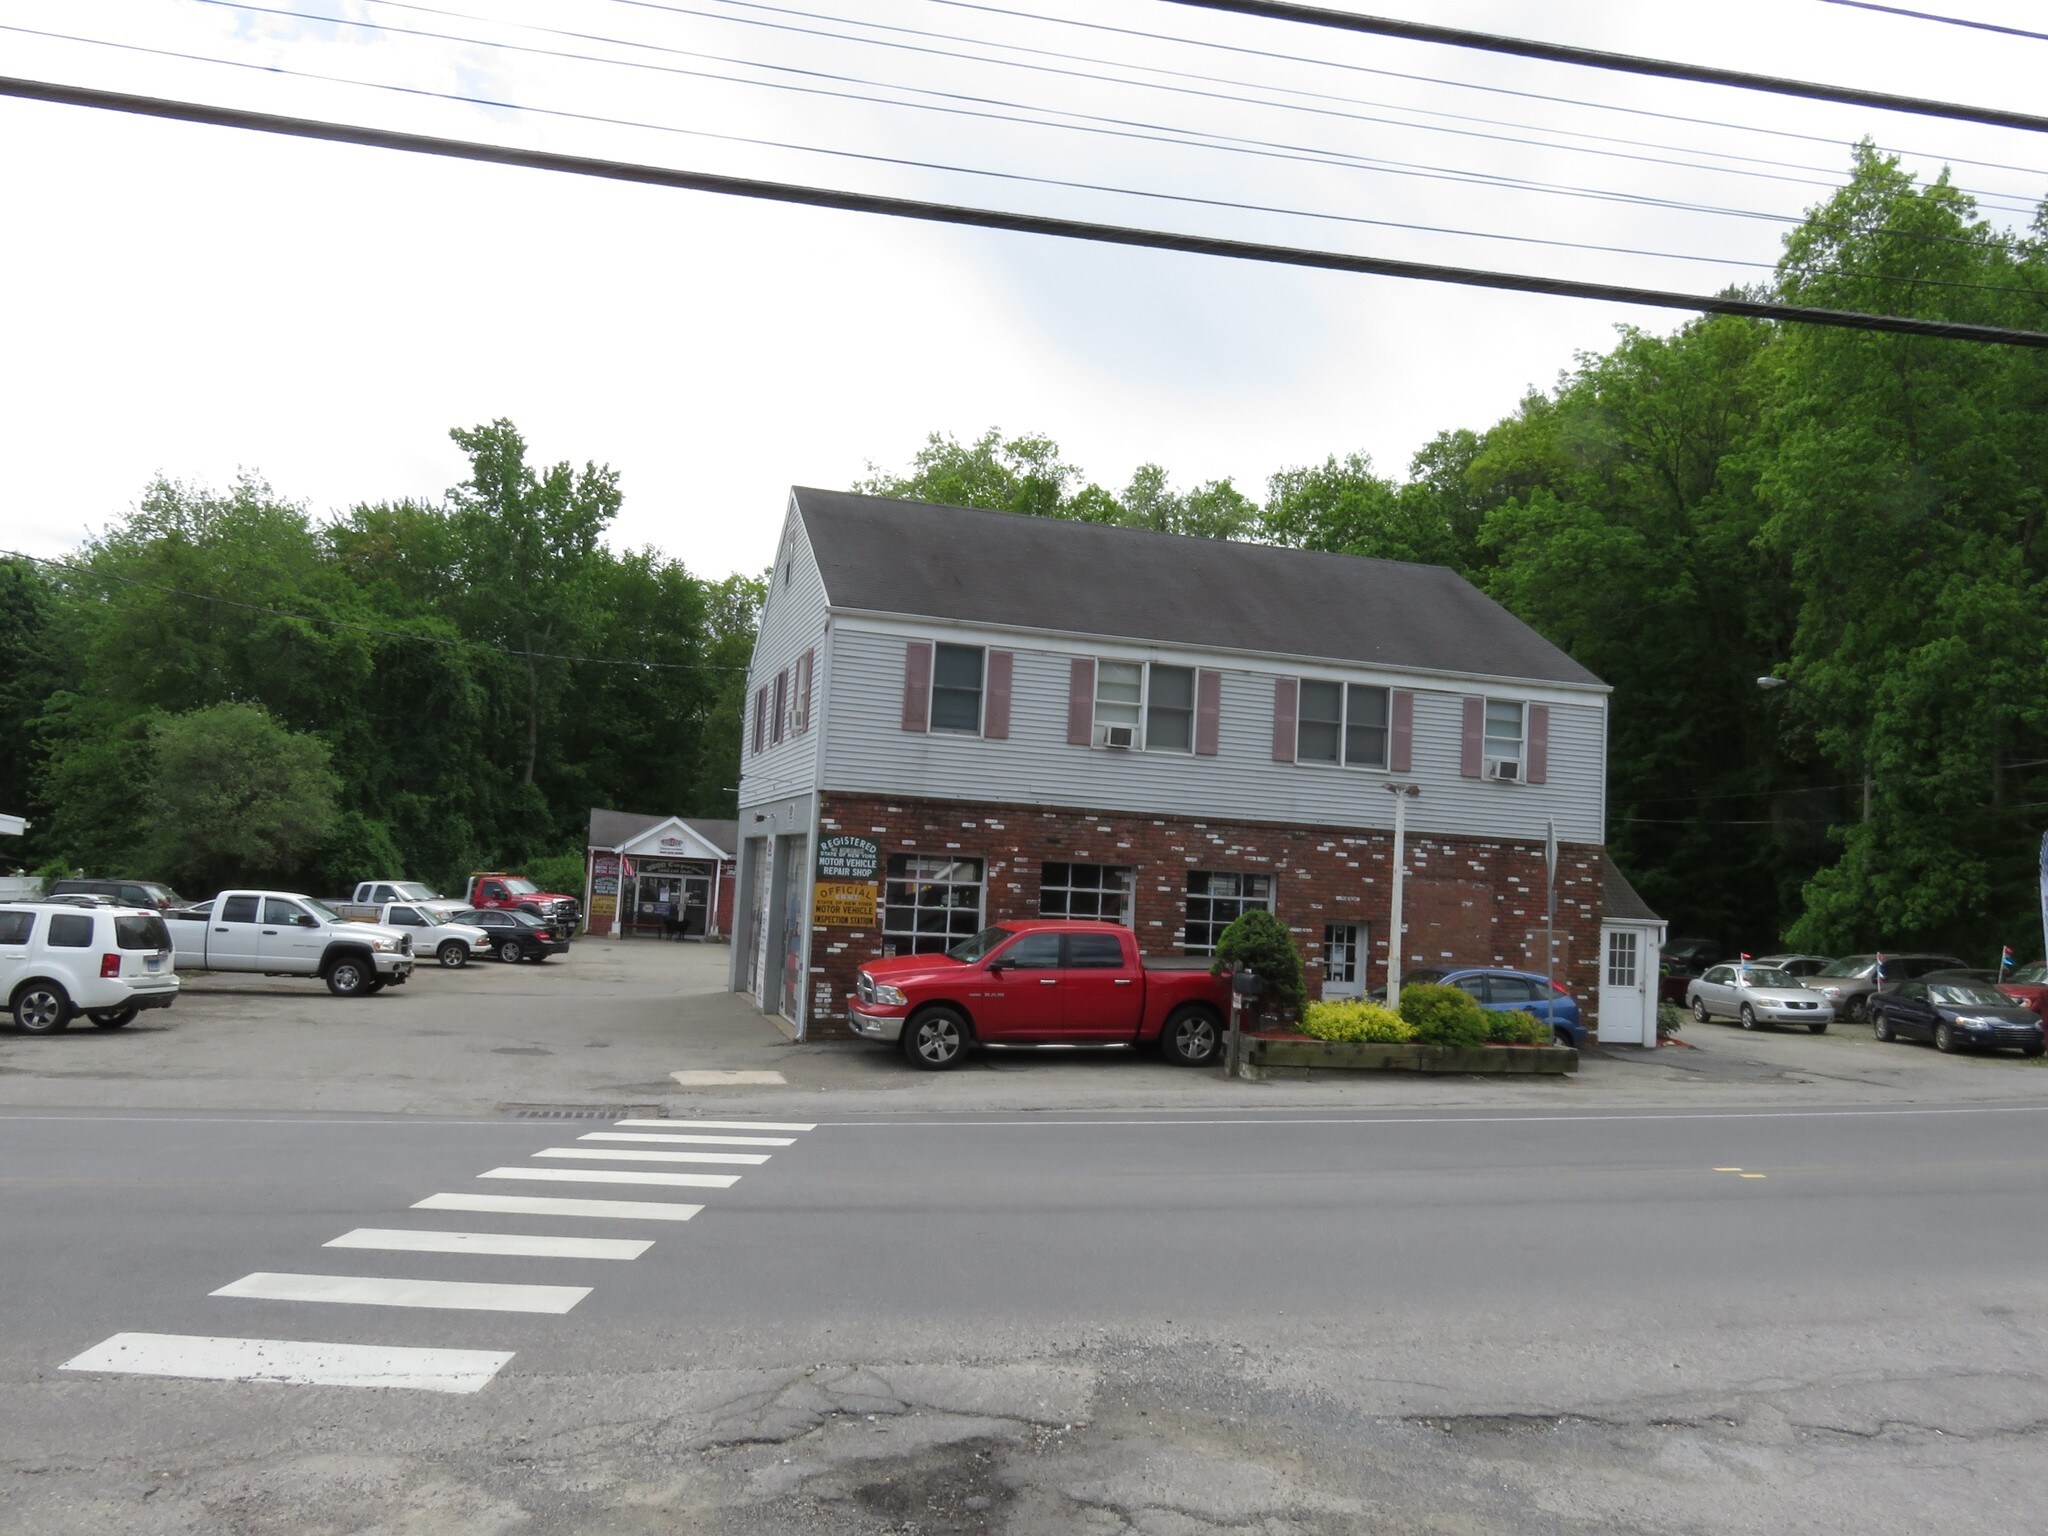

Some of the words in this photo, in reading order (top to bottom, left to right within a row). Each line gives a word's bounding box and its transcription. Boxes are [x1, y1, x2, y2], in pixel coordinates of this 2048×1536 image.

[820, 836, 877, 854] REGISTERED
[819, 857, 844, 866] MOTOR
[846, 858, 877, 868] VEHICLE
[823, 866, 850, 876] REPAIR
[852, 868, 873, 877] SHOP
[820, 886, 872, 900] OFFICIAL
[816, 905, 841, 913] MOTOR
[843, 906, 874, 915] VEHICLE
[814, 915, 849, 924] INSPECTION
[850, 916, 874, 925] STATION
